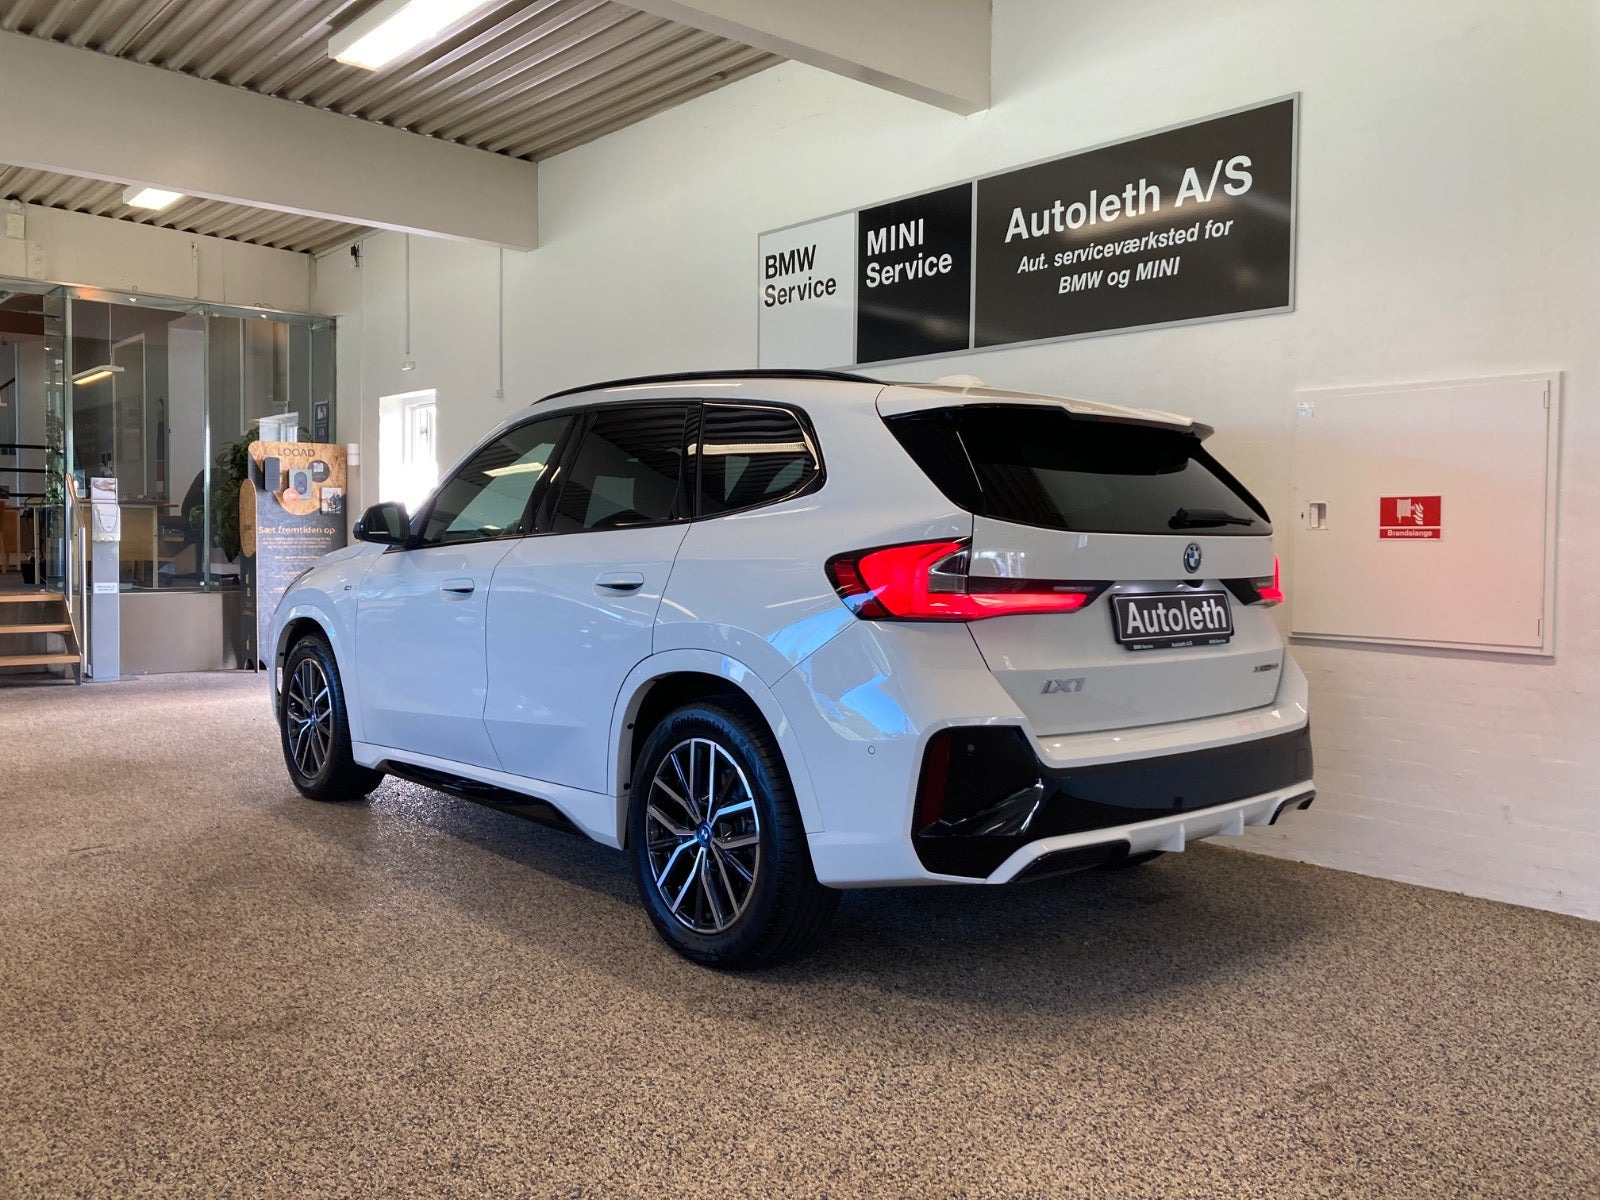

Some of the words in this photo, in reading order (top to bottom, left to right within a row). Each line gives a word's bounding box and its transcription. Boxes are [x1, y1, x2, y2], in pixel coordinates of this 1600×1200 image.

[1005, 178, 1160, 244] Autoleth
[1174, 155, 1253, 208] A/S
[867, 218, 924, 256] MINI
[1017, 255, 1048, 274] Aut.
[1054, 222, 1199, 267] serviceværksted
[1204, 219, 1234, 239] for
[765, 244, 817, 280] BMW
[866, 252, 952, 288] Service
[1058, 269, 1104, 294] BMW
[1107, 268, 1130, 289] og
[1135, 256, 1181, 282] MINI
[764, 276, 837, 307] Service
[277, 448, 316, 457] LOOAD
[258, 526, 276, 535] Sæt
[278, 525, 322, 535] fremtiden
[323, 526, 336, 536] op
[1387, 529, 1433, 538] Brandslange
[1126, 598, 1227, 635] Autoleth
